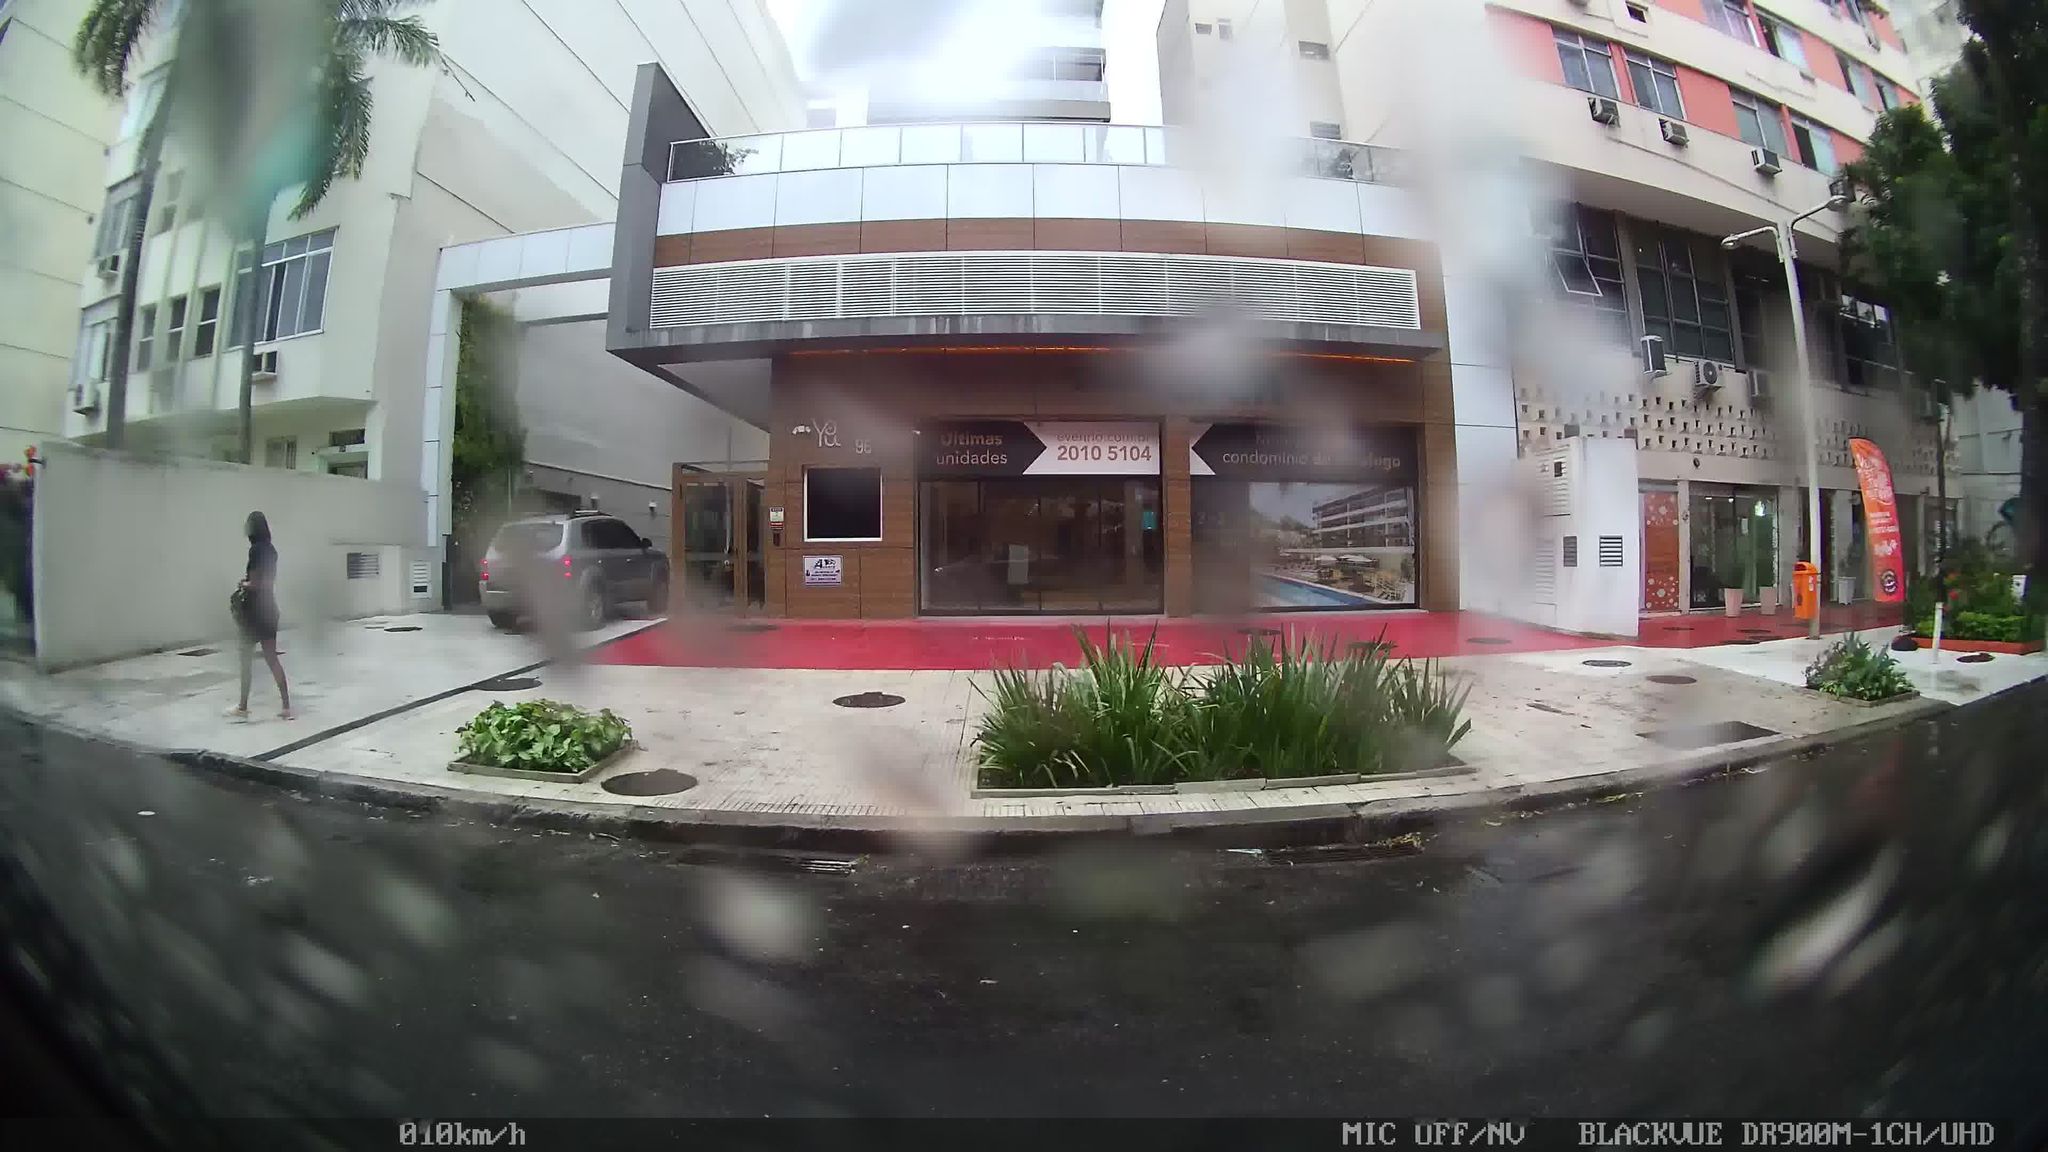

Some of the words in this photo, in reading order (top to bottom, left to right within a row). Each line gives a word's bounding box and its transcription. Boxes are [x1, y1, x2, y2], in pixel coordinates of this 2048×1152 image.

[936, 449, 1008, 464] unidades
[1057, 445, 1102, 461] 2010
[1107, 445, 1152, 461] 5104
